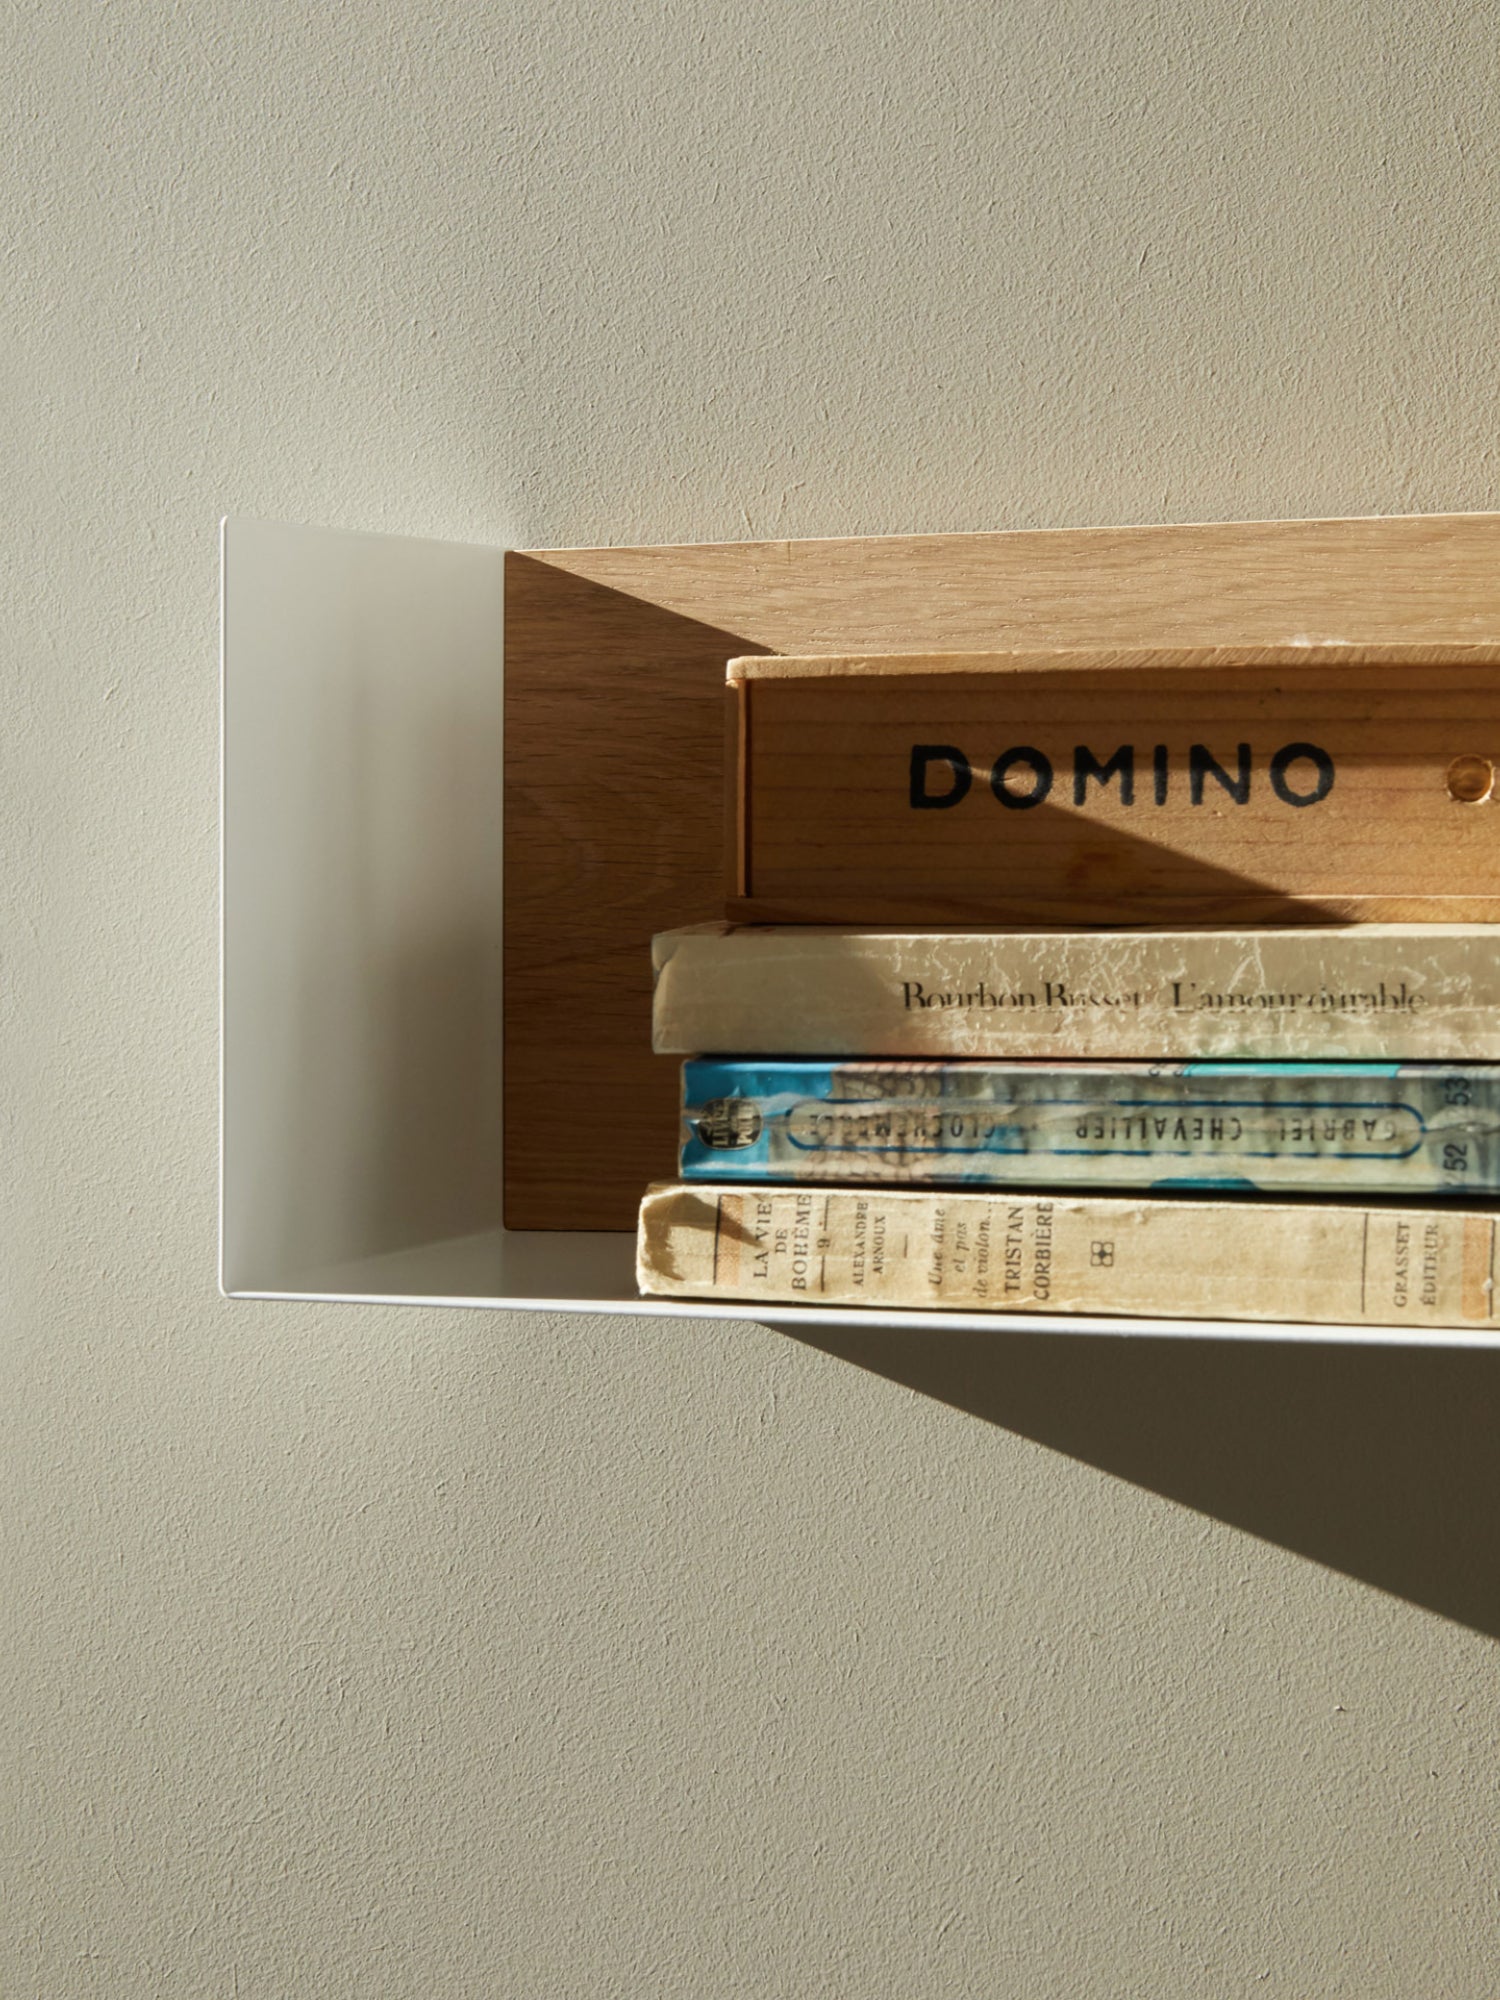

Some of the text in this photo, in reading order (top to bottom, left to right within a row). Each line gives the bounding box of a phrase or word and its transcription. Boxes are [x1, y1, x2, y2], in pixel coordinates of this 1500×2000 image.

[910, 742, 1335, 809] DOMINO
[903, 981, 1036, 1011] Bourbon
[1076, 1117, 1398, 1141] GABRIEL CHEVALLIER
[753, 1202, 773, 1278] LA VIE
[775, 1229, 788, 1253] DE
[792, 1194, 812, 1291] BOHÈME
[817, 1238, 831, 1249] 9
[852, 1201, 868, 1287] ALEXANDRE
[872, 1215, 886, 1275] ARNOUX
[929, 1209, 946, 1286] Une âme
[954, 1222, 970, 1273] et pas
[1005, 1206, 1024, 1294] TRISTAN
[1031, 1202, 1054, 1300] CORBIÈRE
[1393, 1220, 1410, 1308] GRASSET
[1419, 1224, 1439, 1306] ÉDITEUR
[972, 1278, 987, 1298] de
